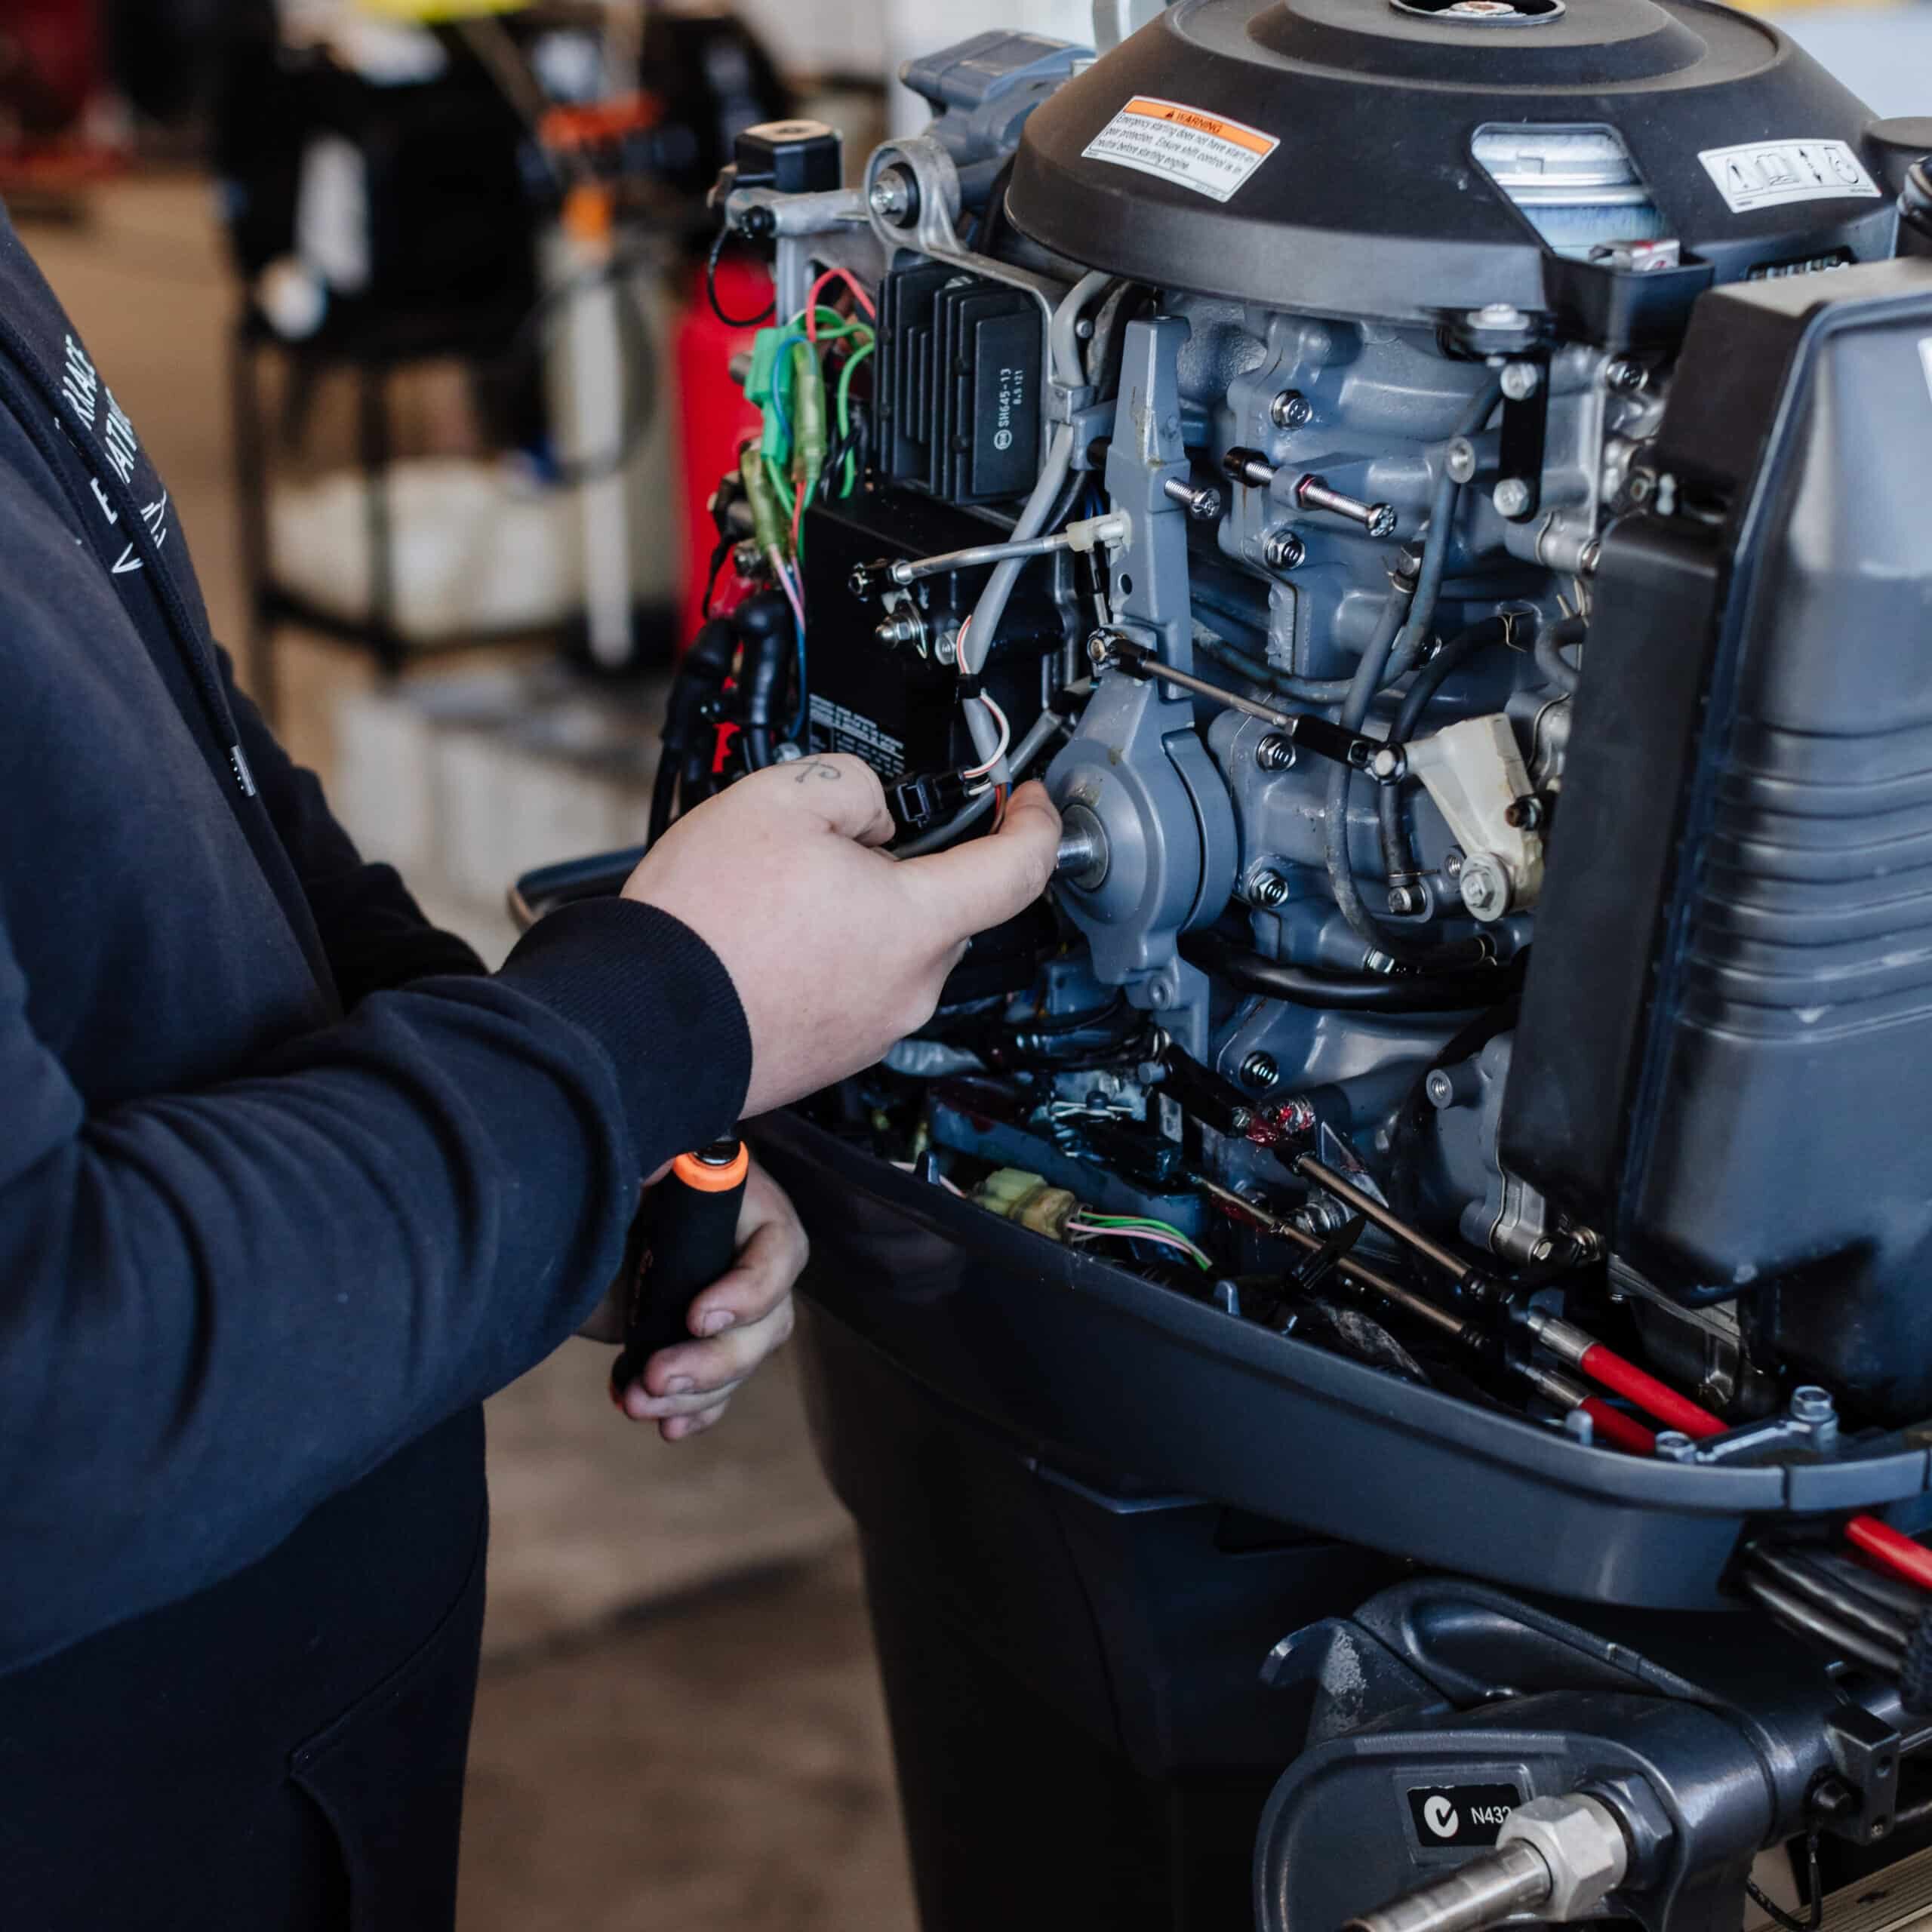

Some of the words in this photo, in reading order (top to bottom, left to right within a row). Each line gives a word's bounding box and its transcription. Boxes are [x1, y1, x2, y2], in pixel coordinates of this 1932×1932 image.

[1150, 122, 1177, 137] starting
[1177, 113, 1222, 134] WARNING
[1137, 147, 1165, 165] starting
[998, 368, 1011, 427] SH645-13
